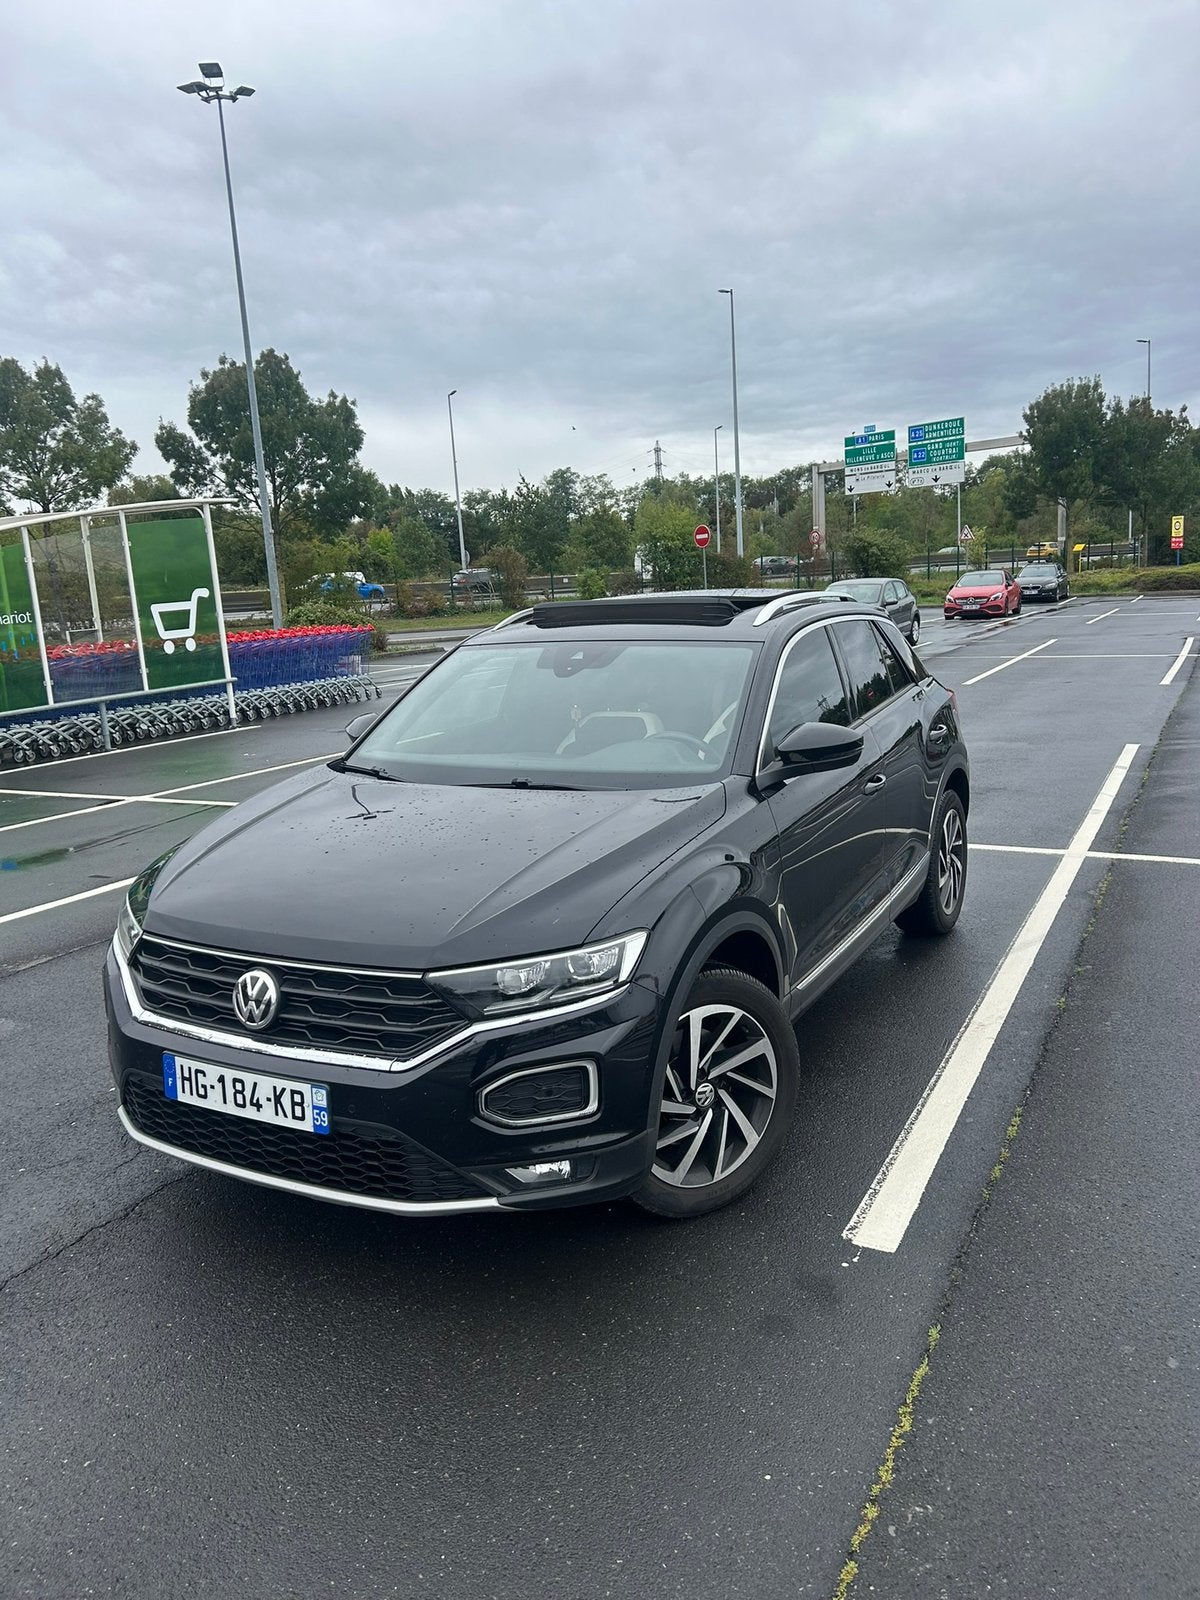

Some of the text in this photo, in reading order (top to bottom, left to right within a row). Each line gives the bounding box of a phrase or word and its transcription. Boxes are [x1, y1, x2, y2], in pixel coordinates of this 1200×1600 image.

[925, 420, 960, 432] DUNKERQUE
[927, 442, 942, 450] GAND
[930, 447, 958, 456] COURTRAI
[846, 454, 874, 463] VILLENEUVE
[0, 611, 32, 624] ariot
[168, 1078, 173, 1086] F
[180, 1064, 306, 1122] HG-184-KB
[313, 1110, 328, 1126] 59
